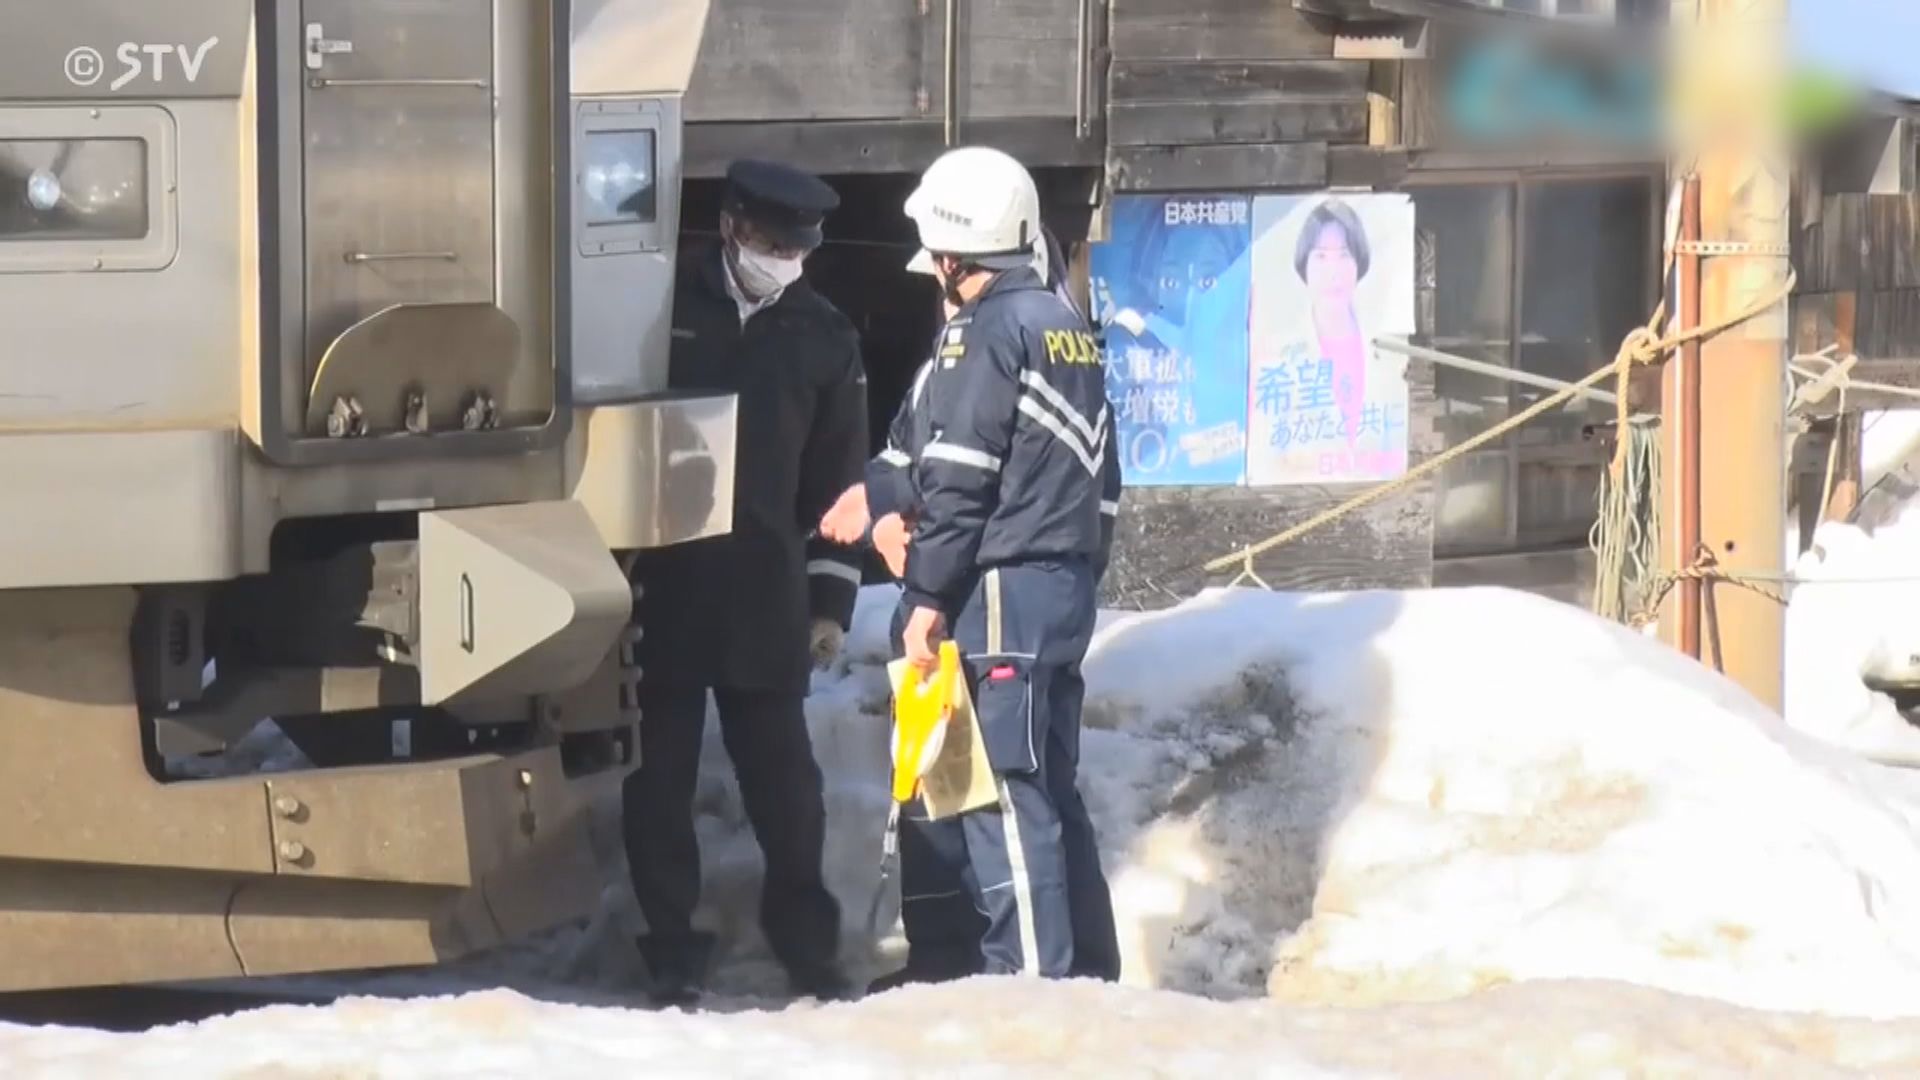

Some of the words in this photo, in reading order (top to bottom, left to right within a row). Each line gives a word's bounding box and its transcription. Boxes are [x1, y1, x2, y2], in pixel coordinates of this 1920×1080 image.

[1164, 201, 1249, 225] 日本共産党
[1043, 329, 1103, 366] POLIC
